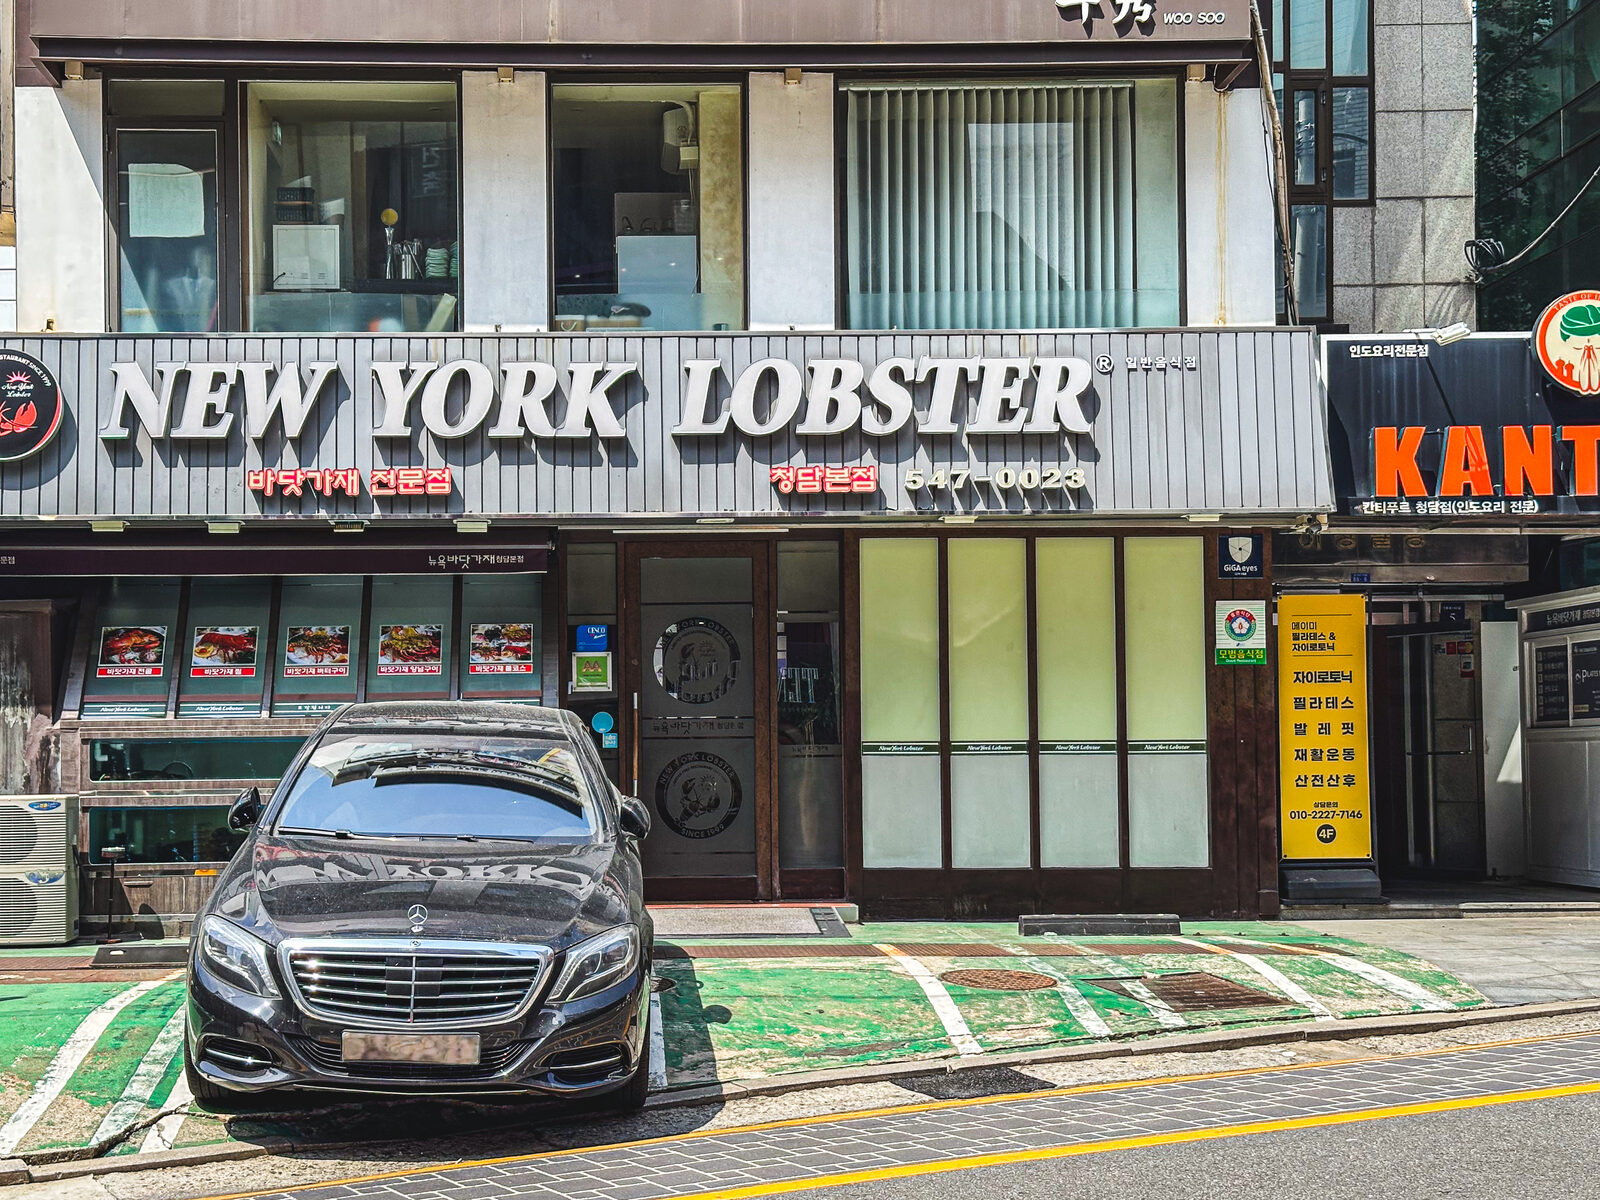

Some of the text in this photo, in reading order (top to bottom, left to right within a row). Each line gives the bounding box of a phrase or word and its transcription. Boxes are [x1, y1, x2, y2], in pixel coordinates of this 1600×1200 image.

[1163, 12, 1193, 24] WOO
[1197, 12, 1226, 24] SOO
[1553, 295, 1578, 311] TASTE
[1349, 344, 1429, 358] 인도요리전문점
[1126, 356, 1196, 369] 일반음식점
[98, 360, 338, 440] NEW
[370, 359, 637, 439] YORK
[671, 354, 1094, 436] LOBSTER
[248, 467, 452, 497] 바닷가재 전문점
[770, 465, 877, 494] 청담본점
[904, 467, 1087, 490] 547-0023
[1362, 501, 1411, 514] 칸티푸르
[1510, 500, 1539, 514] 전문)
[1291, 621, 1317, 631] 에이미
[1292, 632, 1336, 642] 필라테스 &
[1219, 649, 1263, 659] 모범음식점
[1292, 642, 1335, 652] 자이로토닉
[1293, 670, 1353, 684] 자이로토닉
[1293, 696, 1354, 710] 필라테스
[1294, 748, 1356, 762] 재활운동
[701, 754, 736, 778] LOBSTER
[1294, 774, 1356, 788] 산전산후
[1289, 810, 1363, 820] 010-2227-7146
[681, 828, 705, 838] SINCE
[1318, 828, 1335, 839] 4F
